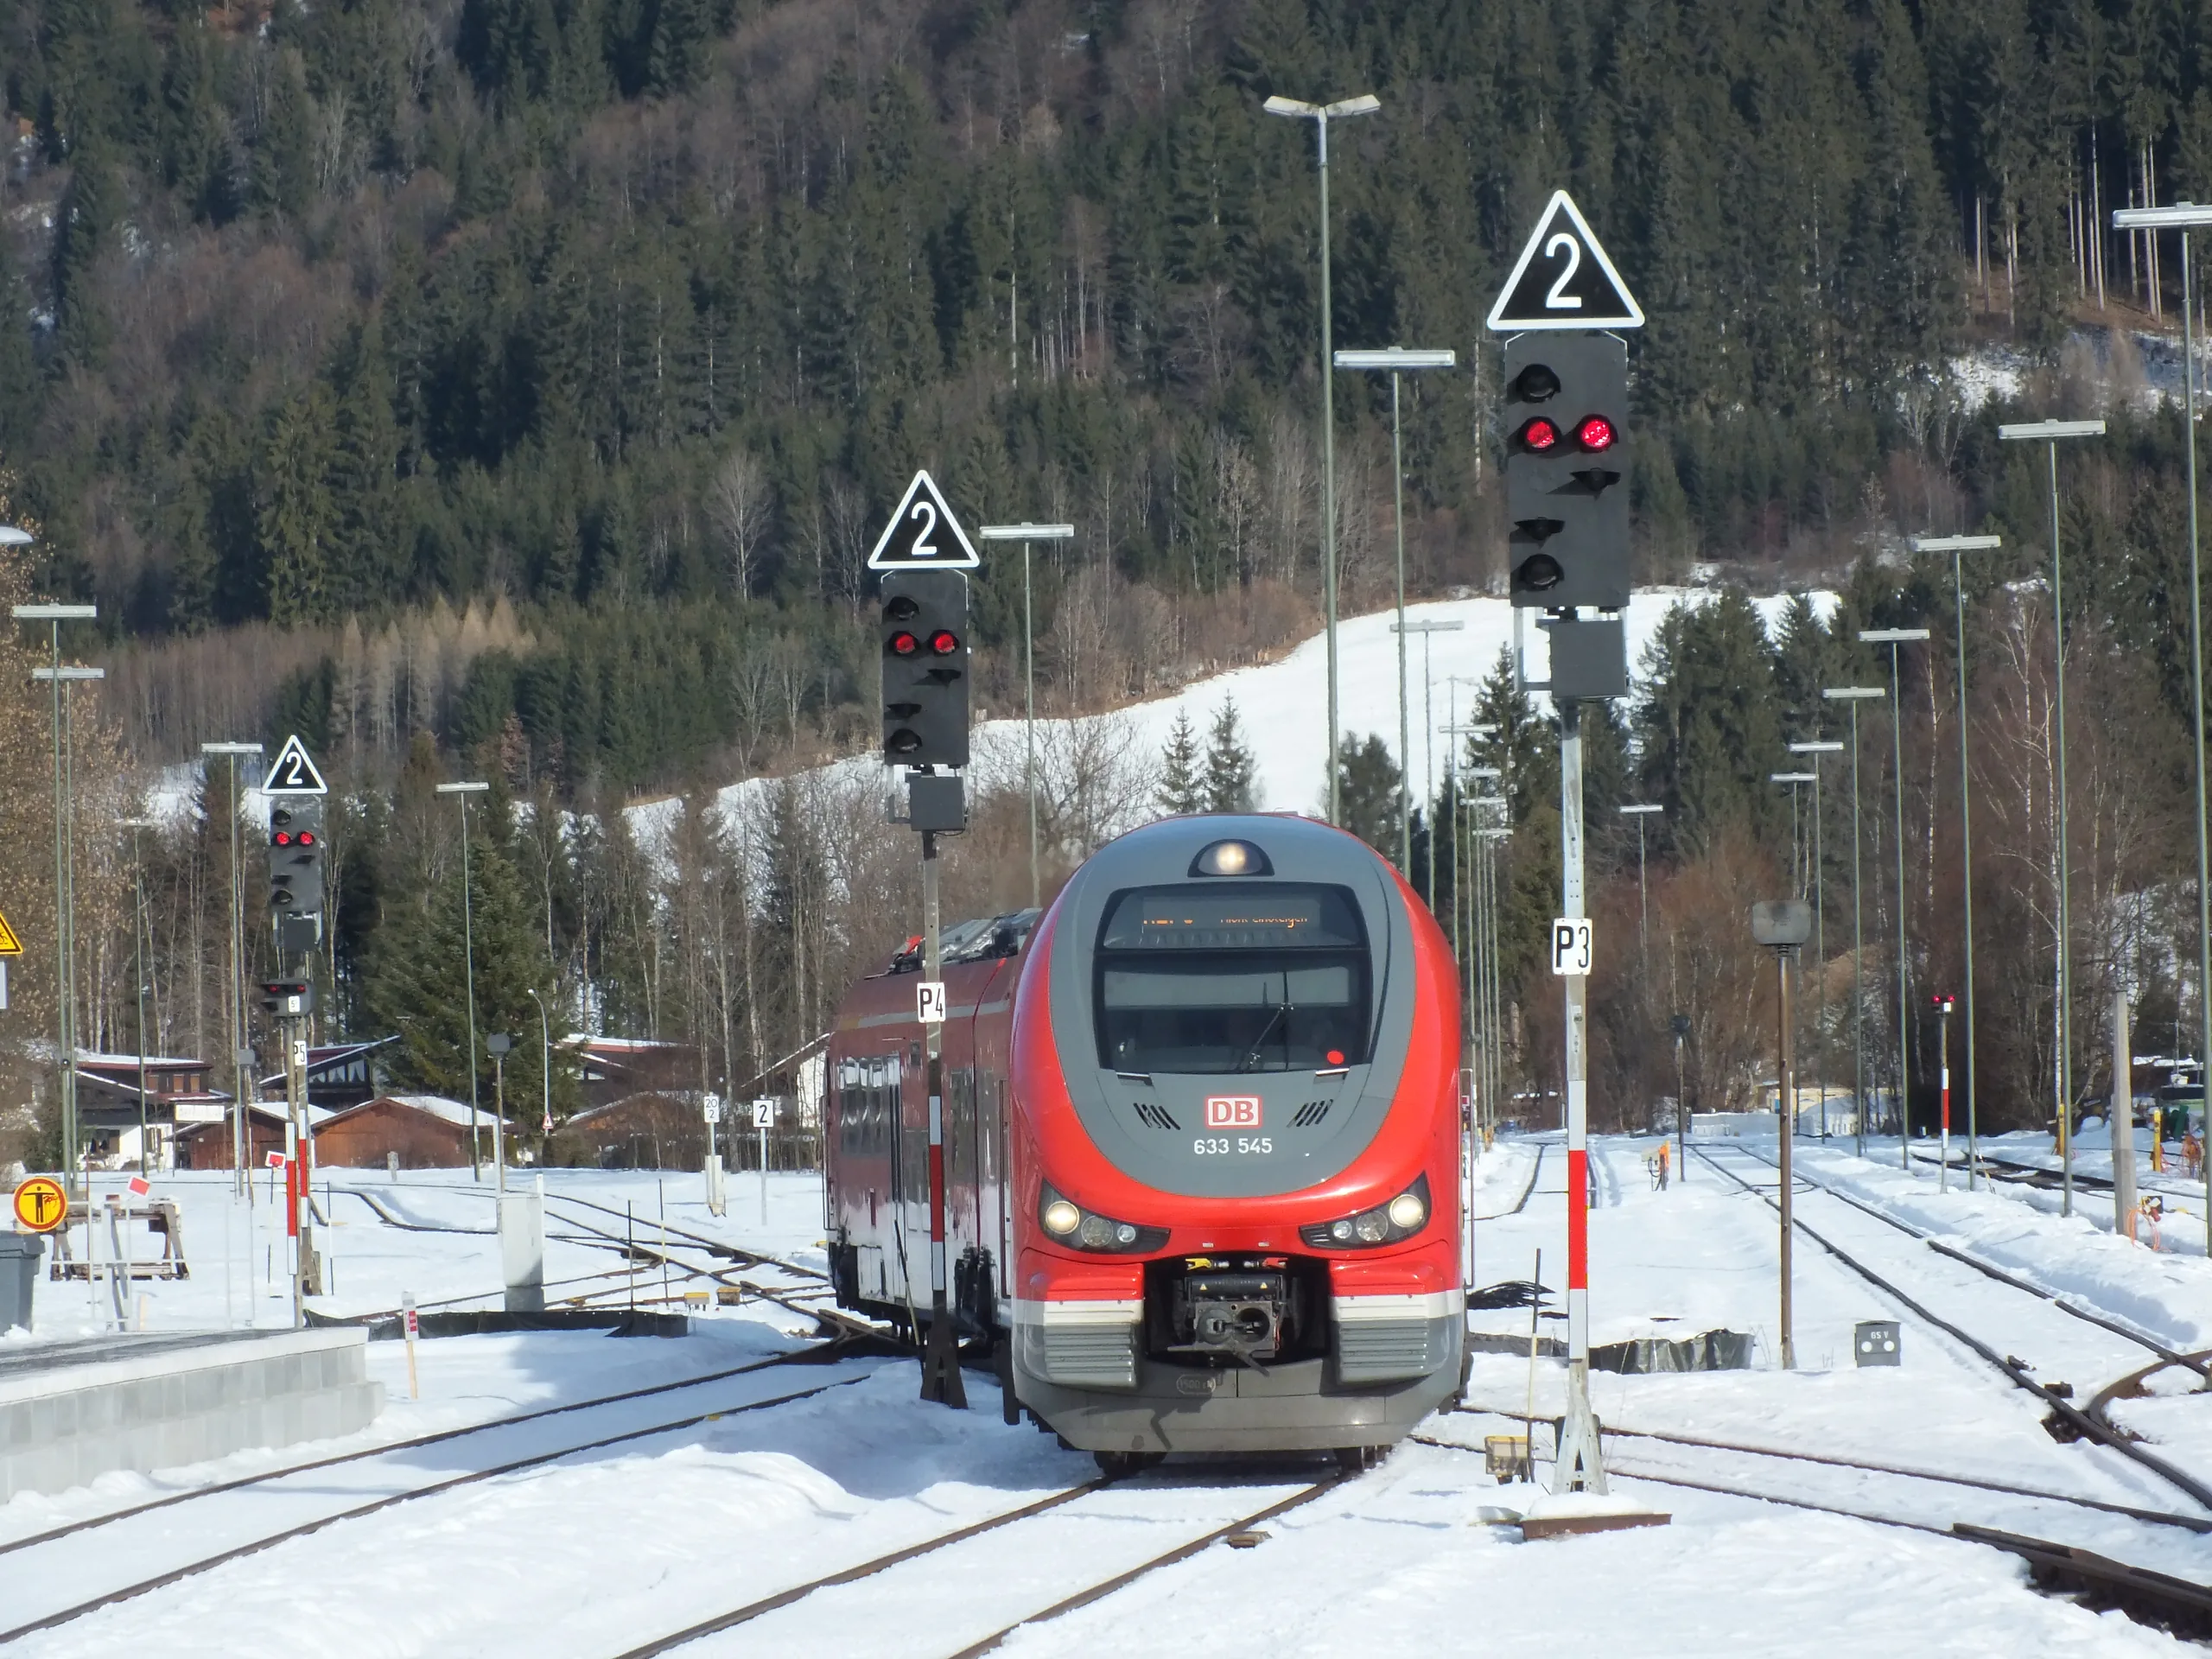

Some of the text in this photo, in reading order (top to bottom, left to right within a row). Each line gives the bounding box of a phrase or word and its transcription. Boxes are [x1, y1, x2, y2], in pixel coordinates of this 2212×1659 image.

[1547, 232, 1582, 308] 2
[911, 501, 938, 556] 2
[286, 752, 303, 785] 2
[1555, 925, 1590, 969] P3
[919, 988, 944, 1018] P4
[705, 1098, 718, 1109] 20
[709, 1109, 715, 1119] 2
[759, 1104, 768, 1123] 2
[1212, 1100, 1255, 1123] DB
[1193, 1137, 1273, 1154] 633 545
